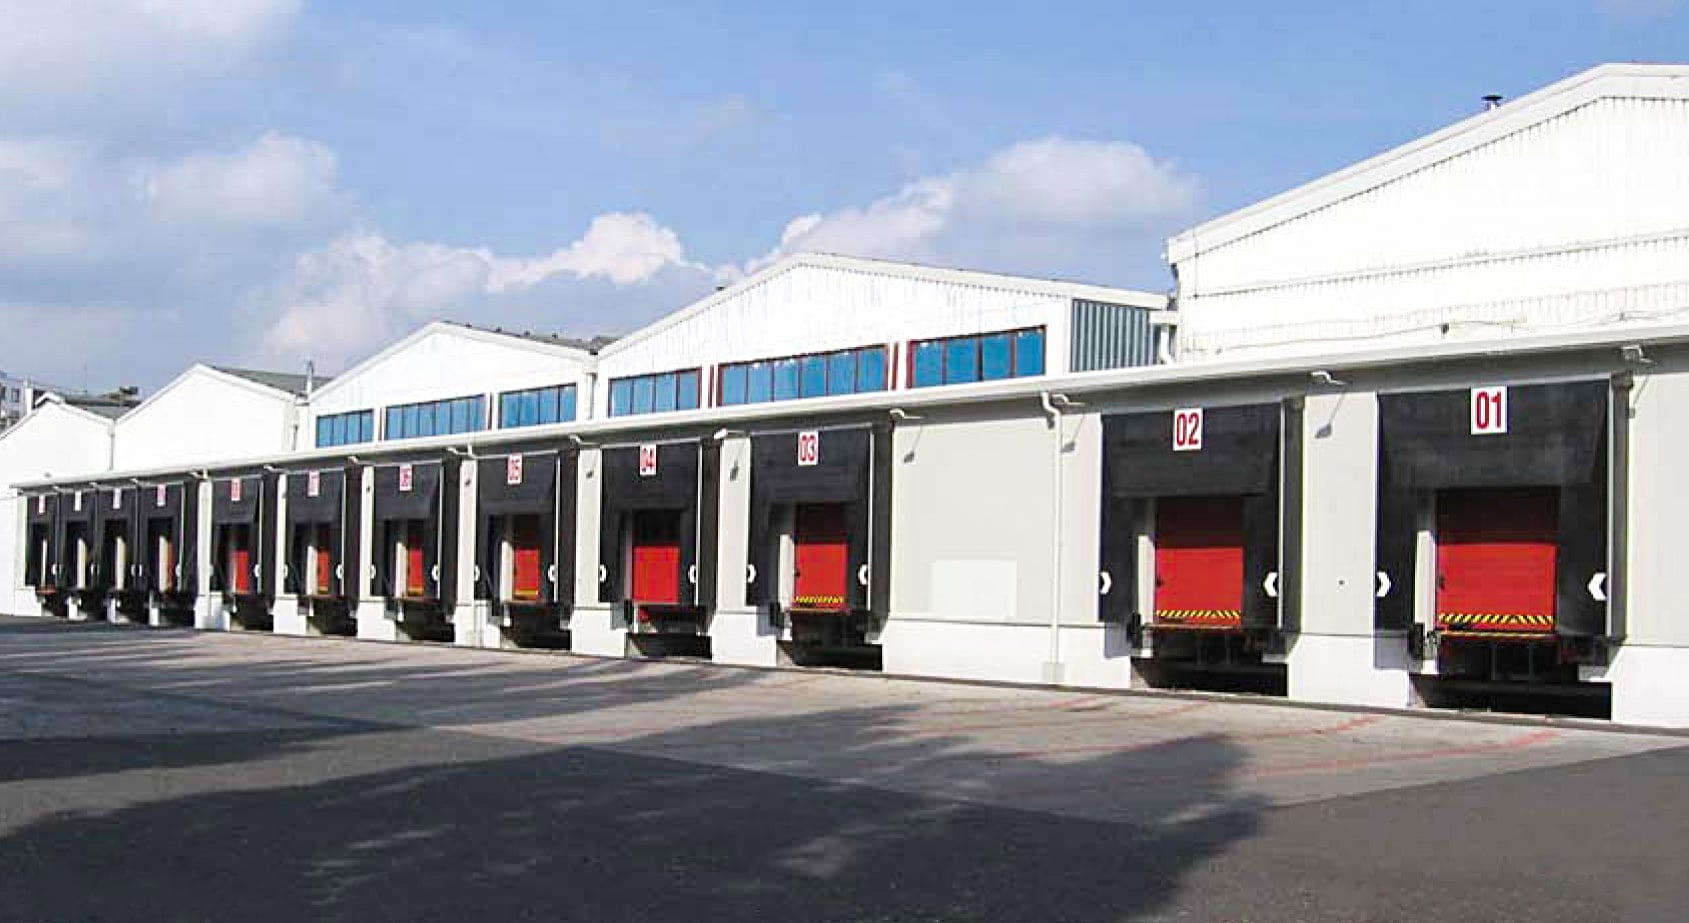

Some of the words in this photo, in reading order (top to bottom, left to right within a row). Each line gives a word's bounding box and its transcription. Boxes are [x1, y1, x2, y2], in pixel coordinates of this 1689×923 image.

[1476, 391, 1502, 429] 01
[1176, 412, 1200, 446] 02
[641, 447, 656, 472] 04
[800, 434, 817, 462] 03
